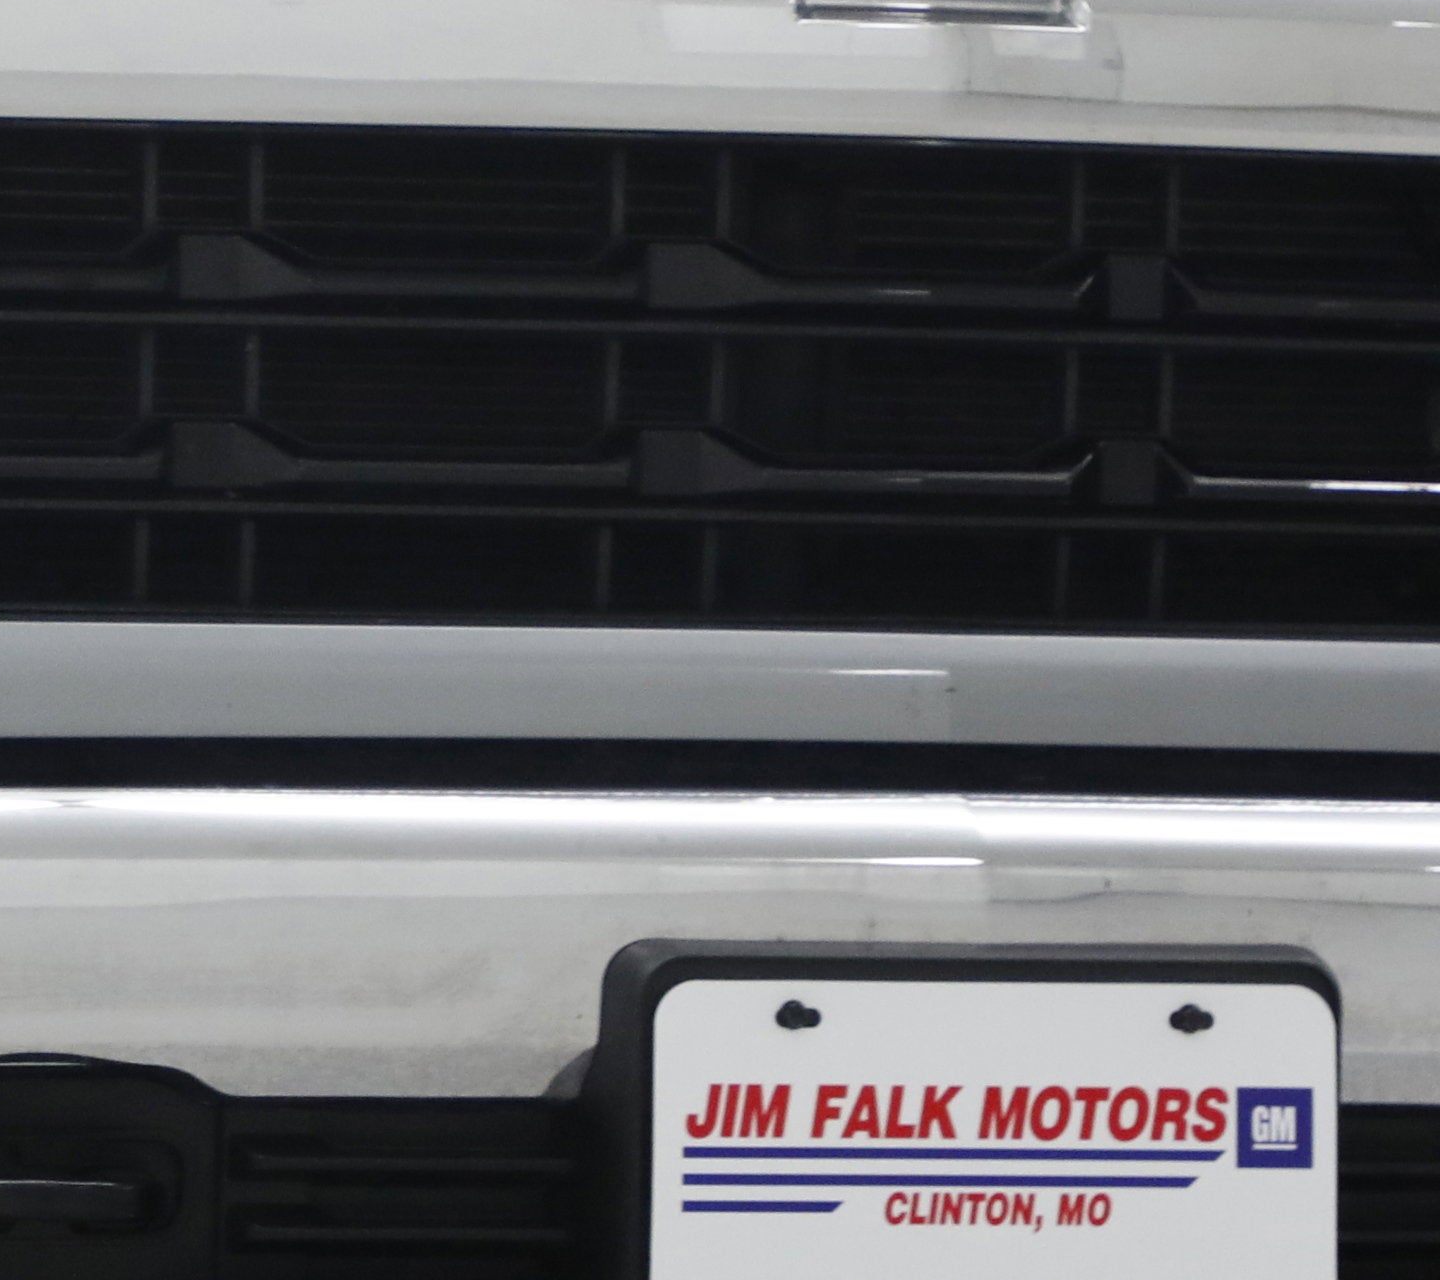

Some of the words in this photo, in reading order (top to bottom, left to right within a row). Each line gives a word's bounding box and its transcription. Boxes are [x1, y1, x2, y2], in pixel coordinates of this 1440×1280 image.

[685, 1084, 791, 1140] JIM
[811, 1084, 962, 1140] FALK
[978, 1085, 1229, 1142] MOTORS
[1251, 1105, 1297, 1143] GM
[885, 1192, 1043, 1232] CLINTON,
[1057, 1193, 1112, 1226] MO
